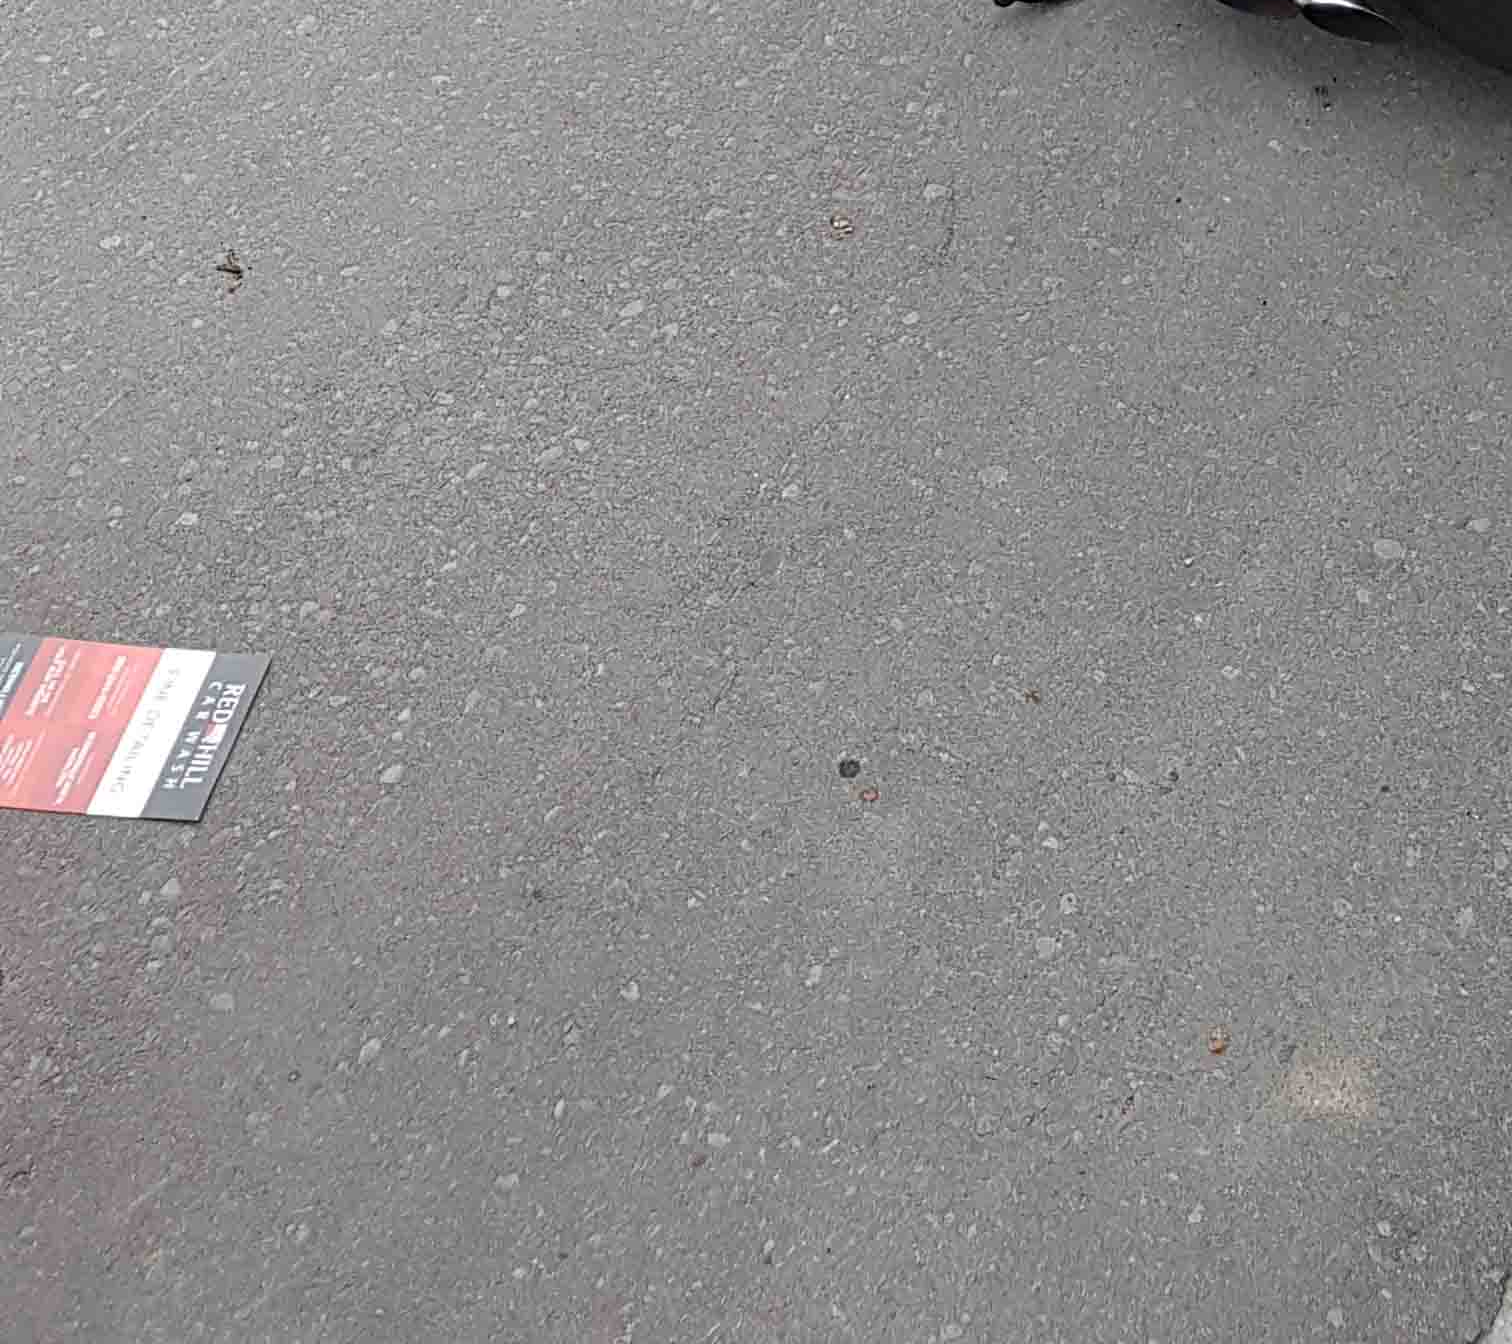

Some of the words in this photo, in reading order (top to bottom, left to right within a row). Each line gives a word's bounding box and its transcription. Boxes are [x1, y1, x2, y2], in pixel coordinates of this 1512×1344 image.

[194, 680, 223, 720] CAR
[211, 683, 246, 723] RED
[162, 730, 201, 789] WASH
[180, 734, 221, 790] HILL
